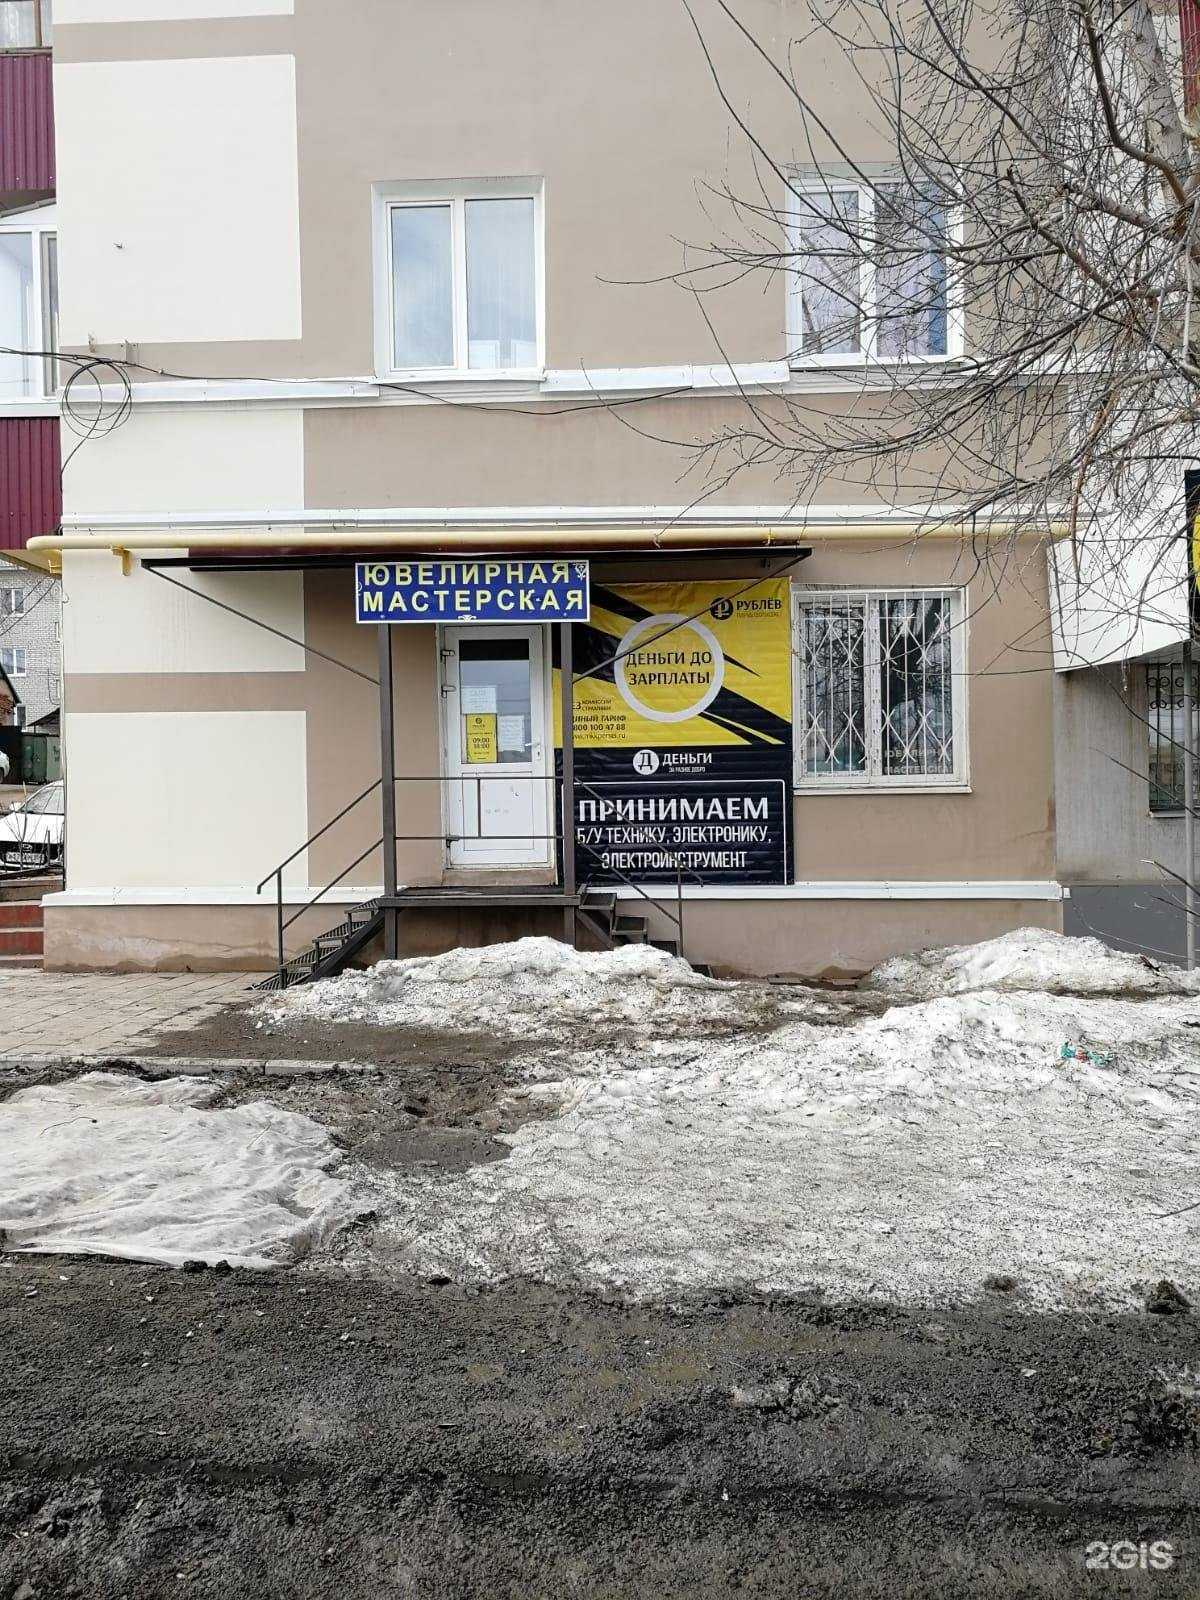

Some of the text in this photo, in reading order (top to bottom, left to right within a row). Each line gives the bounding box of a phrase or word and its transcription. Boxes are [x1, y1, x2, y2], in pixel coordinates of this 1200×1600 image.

[364, 563, 570, 586] ЮВЕЛИРНАЯ
[363, 589, 583, 612] МАСТЕРСКАЯ
[736, 597, 782, 610] РУБЛЁВ
[626, 651, 712, 668] ДЕНЬГИ ДО
[628, 671, 710, 685] ЗАРПЛАТЫ
[601, 714, 626, 722] ТАРИФ
[590, 723, 604, 731] 100
[606, 723, 614, 731] 47
[662, 752, 713, 767] ДЕНЬГИ
[578, 797, 769, 822] ПРИНИМАЕМ
[577, 825, 772, 844] Б/У ТЕХНИКУ, ЭЛЕКТРОНИКУ,
[601, 851, 748, 869] ЭЛЕКТРОИНСТРУМЕНТ
